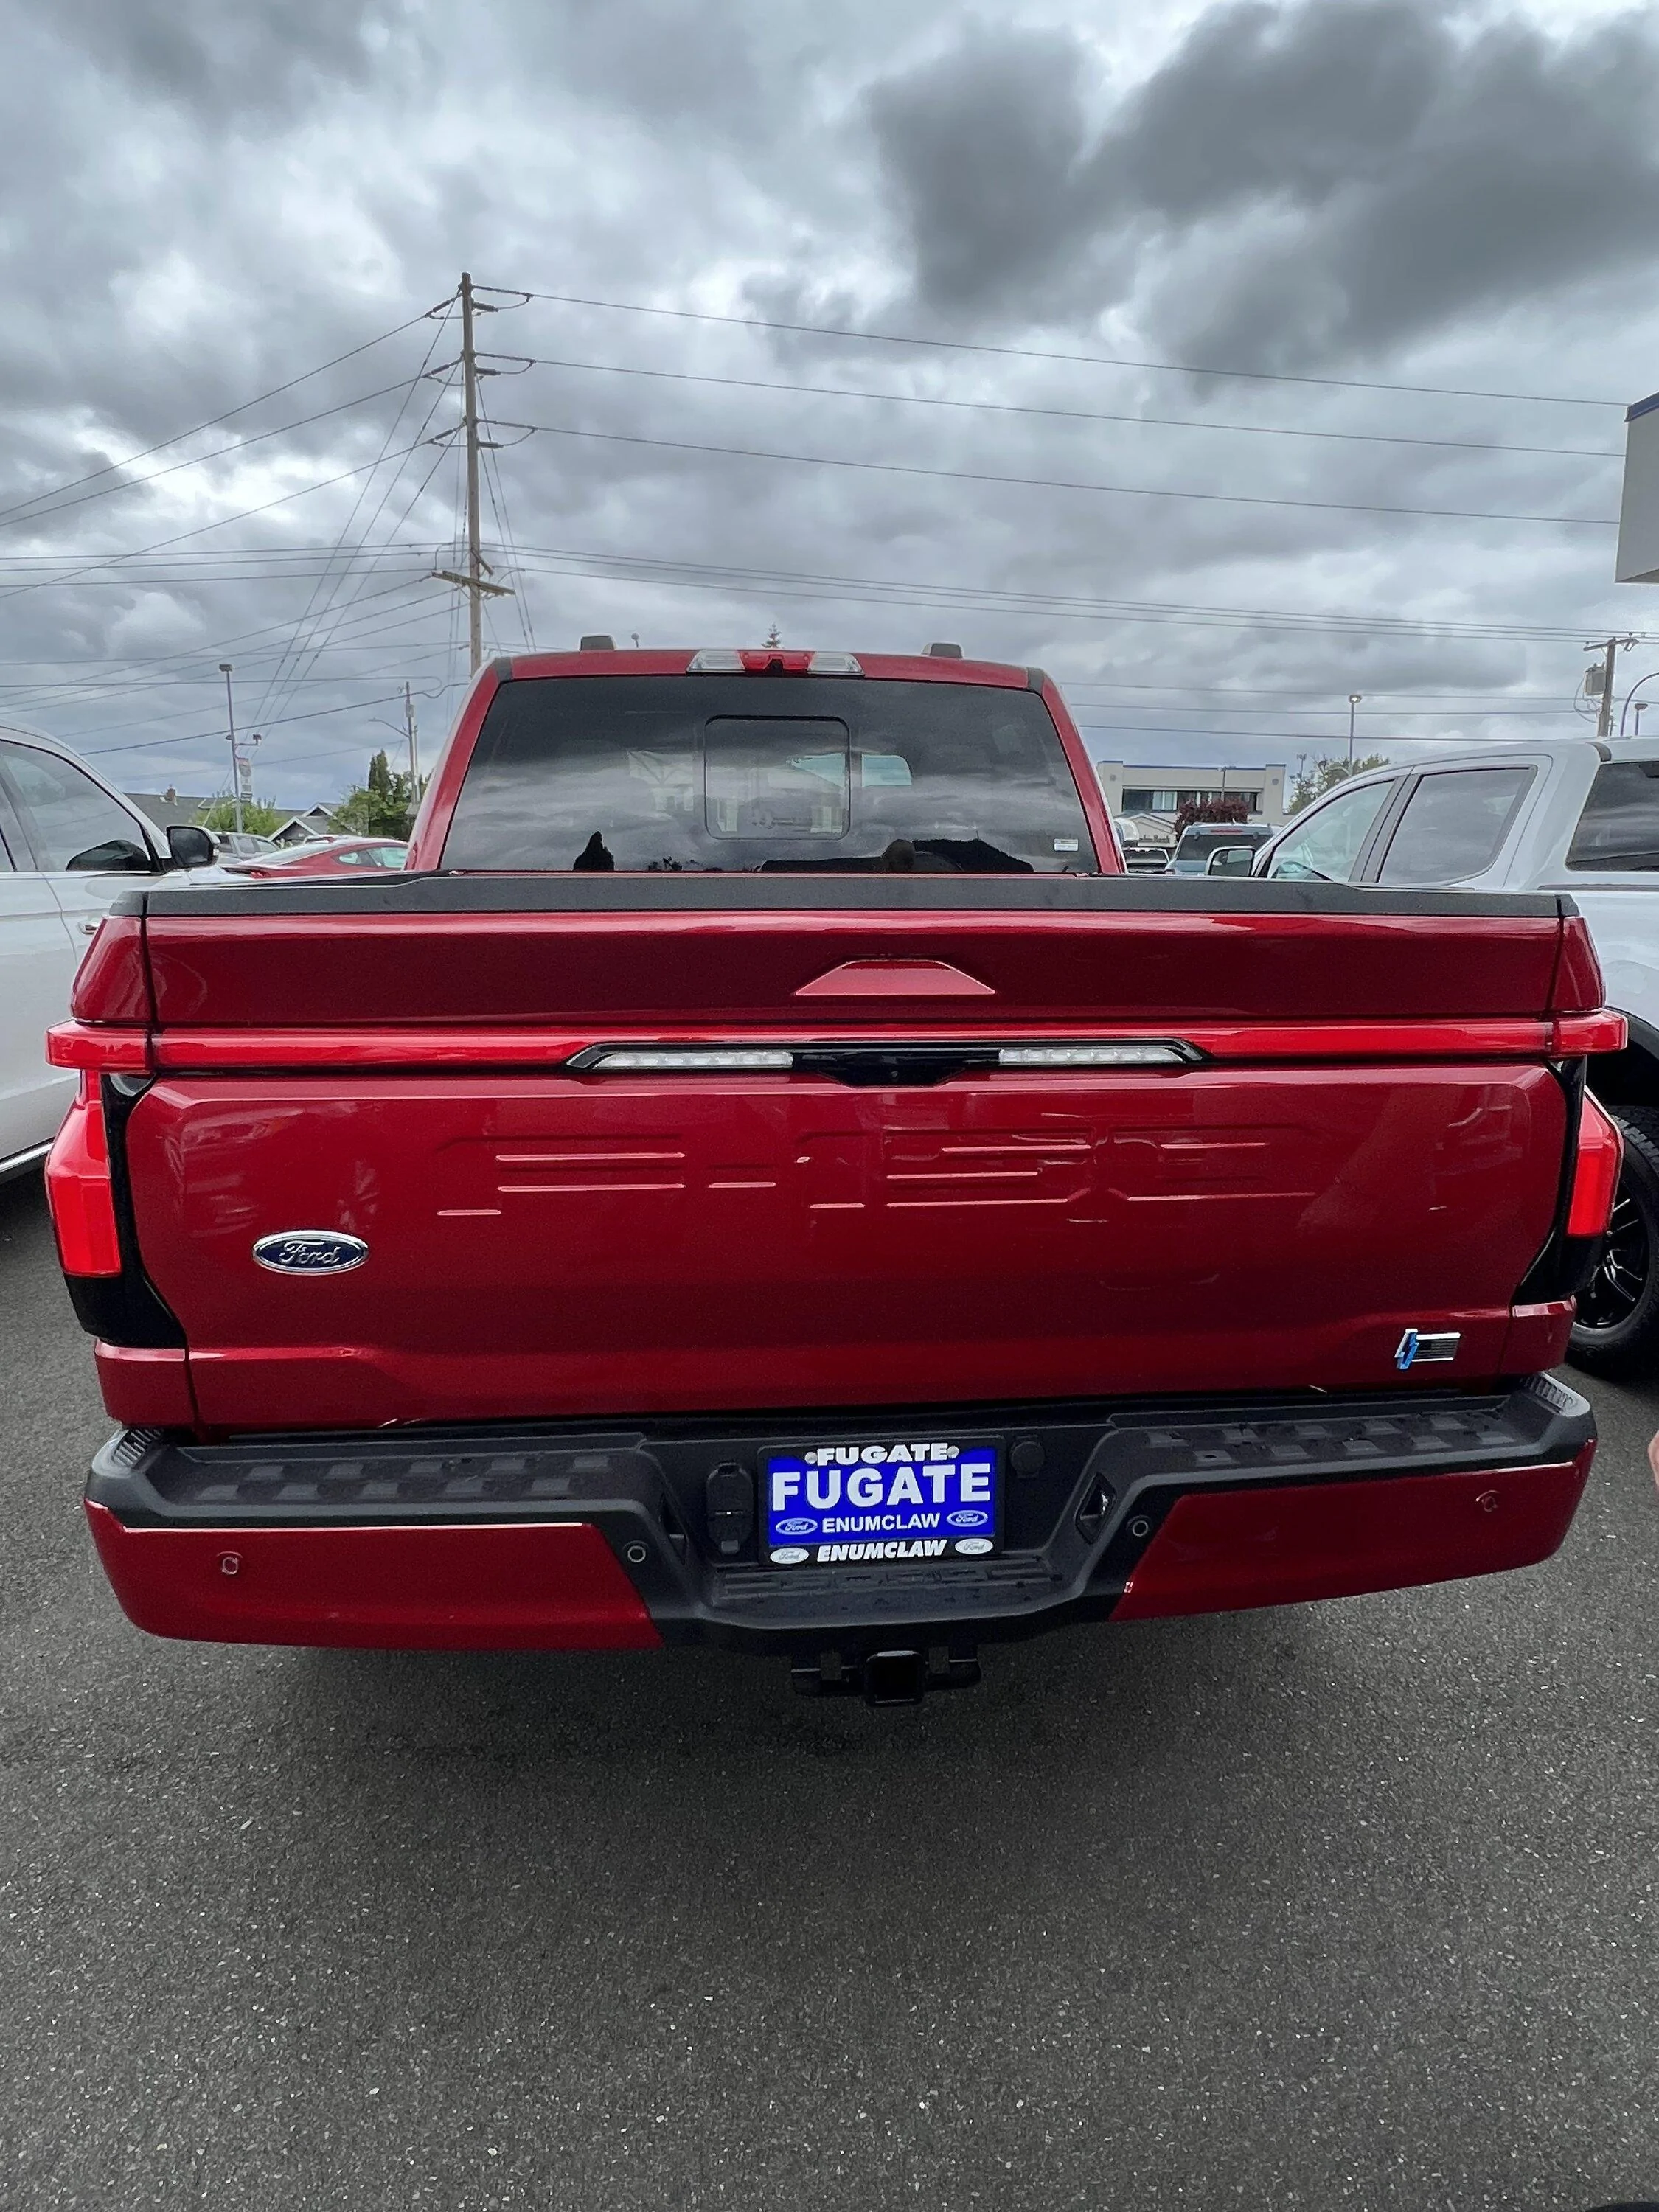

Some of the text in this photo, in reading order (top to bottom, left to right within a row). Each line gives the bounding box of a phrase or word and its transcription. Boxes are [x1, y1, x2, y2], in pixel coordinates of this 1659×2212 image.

[279, 1240, 341, 1265] Ford
[817, 1443, 948, 1466] FUGATE
[773, 1463, 990, 1511] FUGATE
[821, 1513, 940, 1533] ENUMCLAW
[817, 1540, 947, 1562] ENUMCLAW
